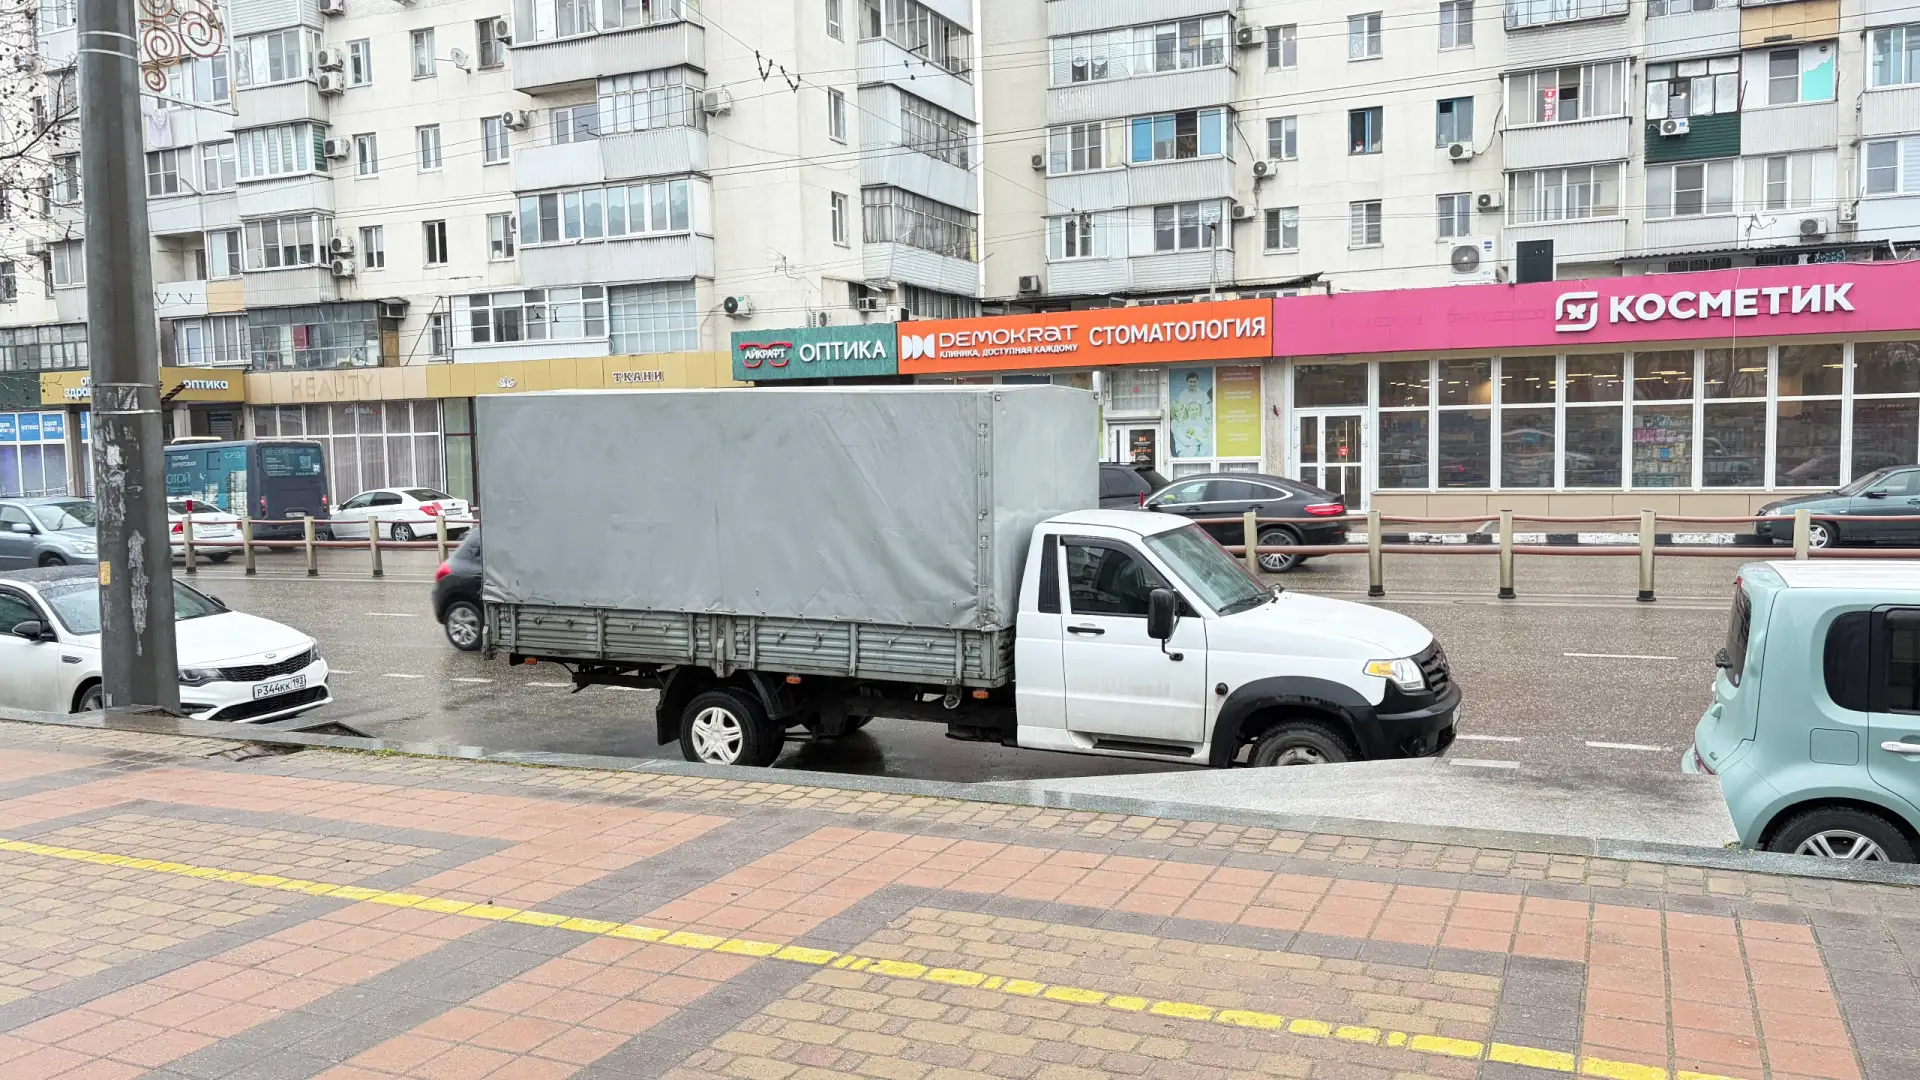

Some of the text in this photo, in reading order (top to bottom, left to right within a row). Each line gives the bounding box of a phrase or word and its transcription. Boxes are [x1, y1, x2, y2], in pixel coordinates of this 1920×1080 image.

[1609, 282, 1855, 323] КОСМЕТИК
[1089, 316, 1266, 346] СТОМАТОЛОГИЯ
[745, 347, 786, 360] АЙКРАФТ
[799, 339, 887, 362] ОПТИКА
[940, 343, 1079, 359] КЛИНИКА, ДОСТУПНАЯ КАЖДОМУ
[613, 370, 664, 382] ТКАНИ
[183, 379, 228, 390] оптика
[64, 386, 92, 400] здра
[166, 471, 191, 485] ОТОЙ
[292, 676, 304, 687] 193
